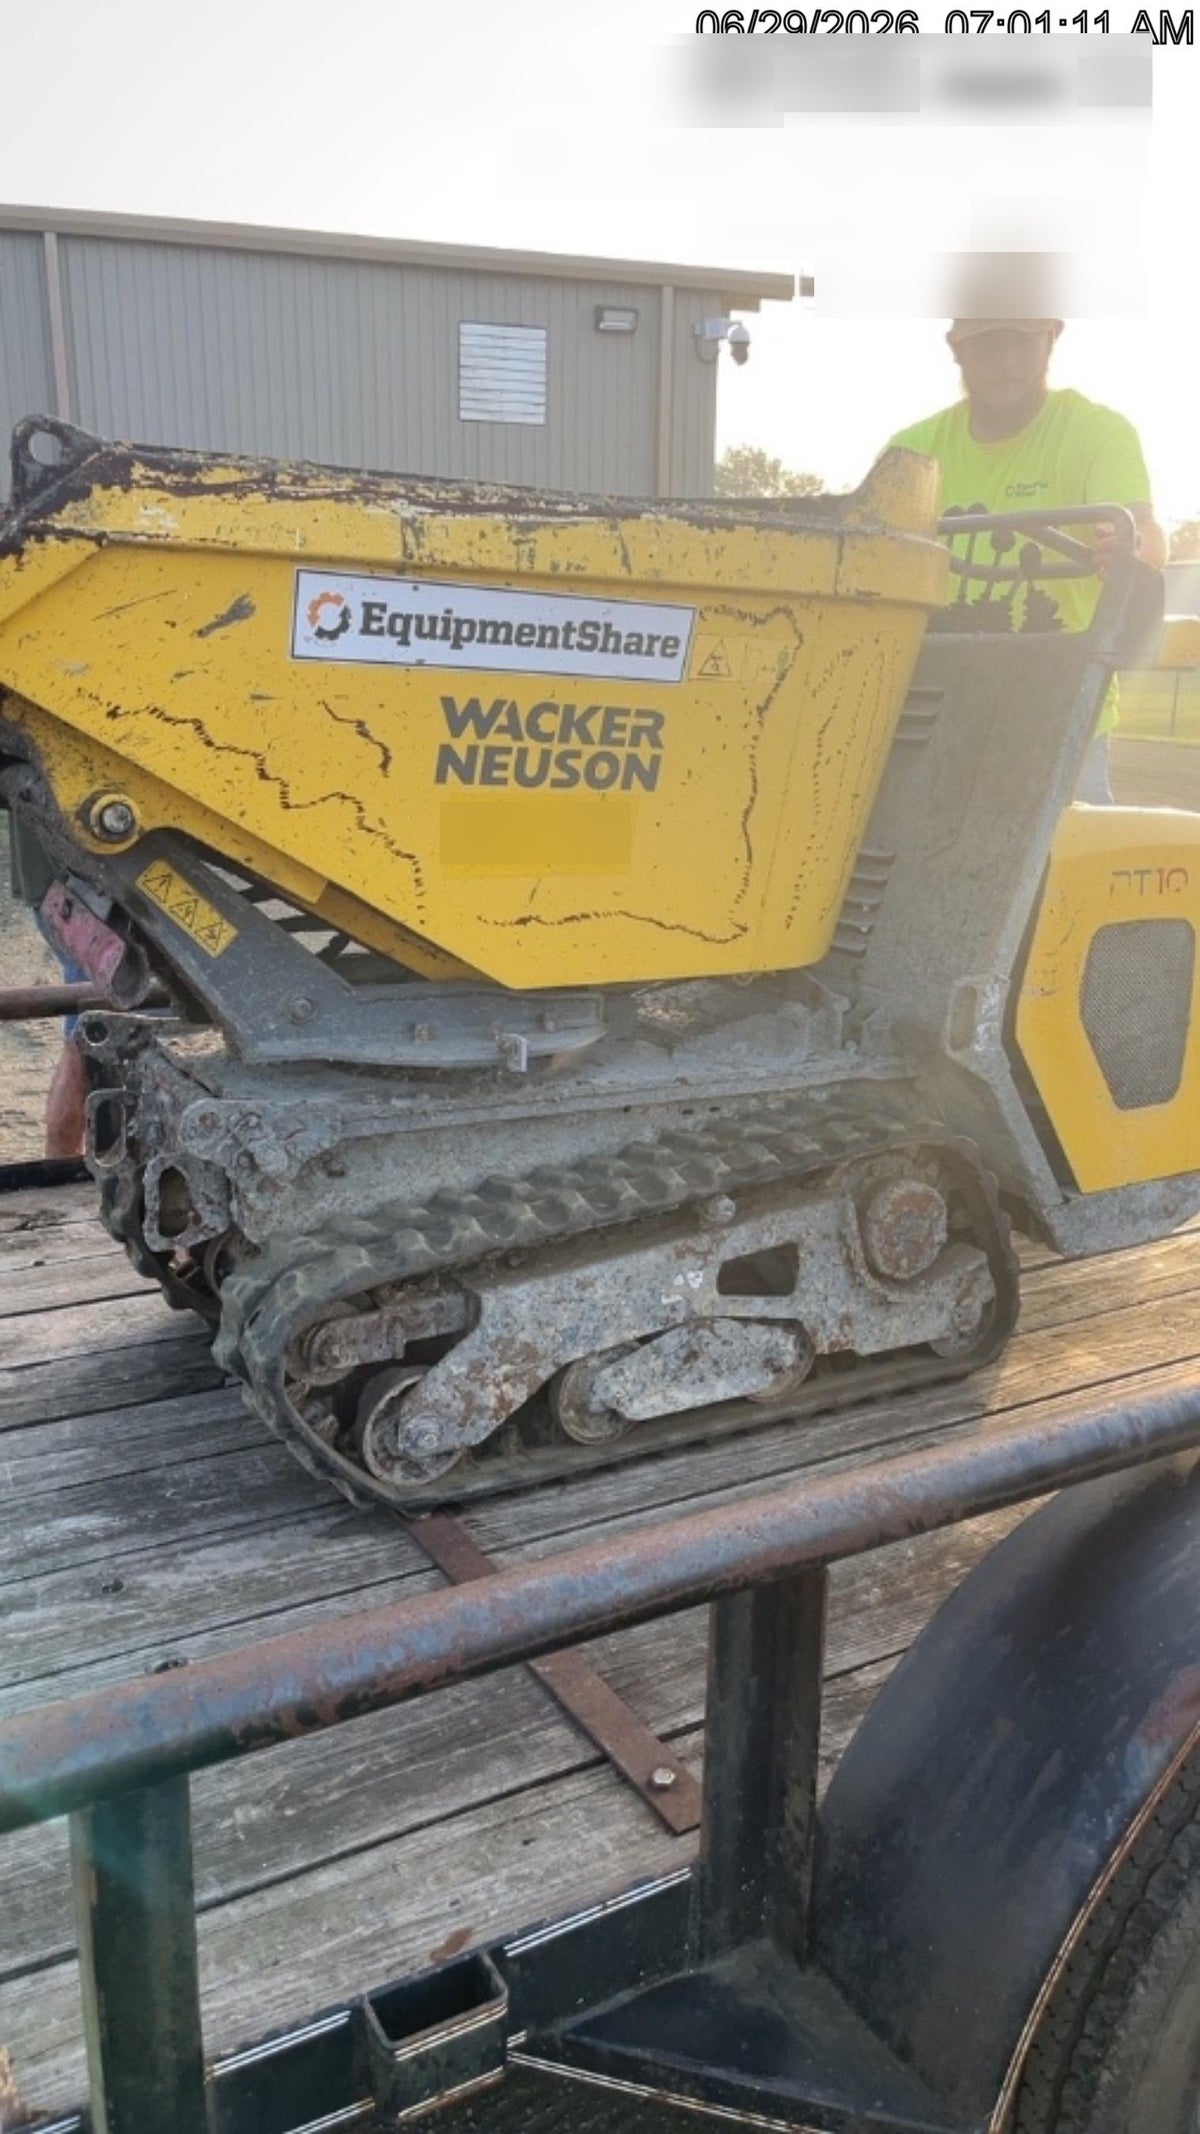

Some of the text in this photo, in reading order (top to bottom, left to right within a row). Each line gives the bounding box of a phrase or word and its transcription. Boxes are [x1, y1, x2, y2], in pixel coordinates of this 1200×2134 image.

[360, 601, 680, 658] EquipmentShare
[440, 696, 665, 748] WACKER
[434, 743, 662, 792] NEUSON
